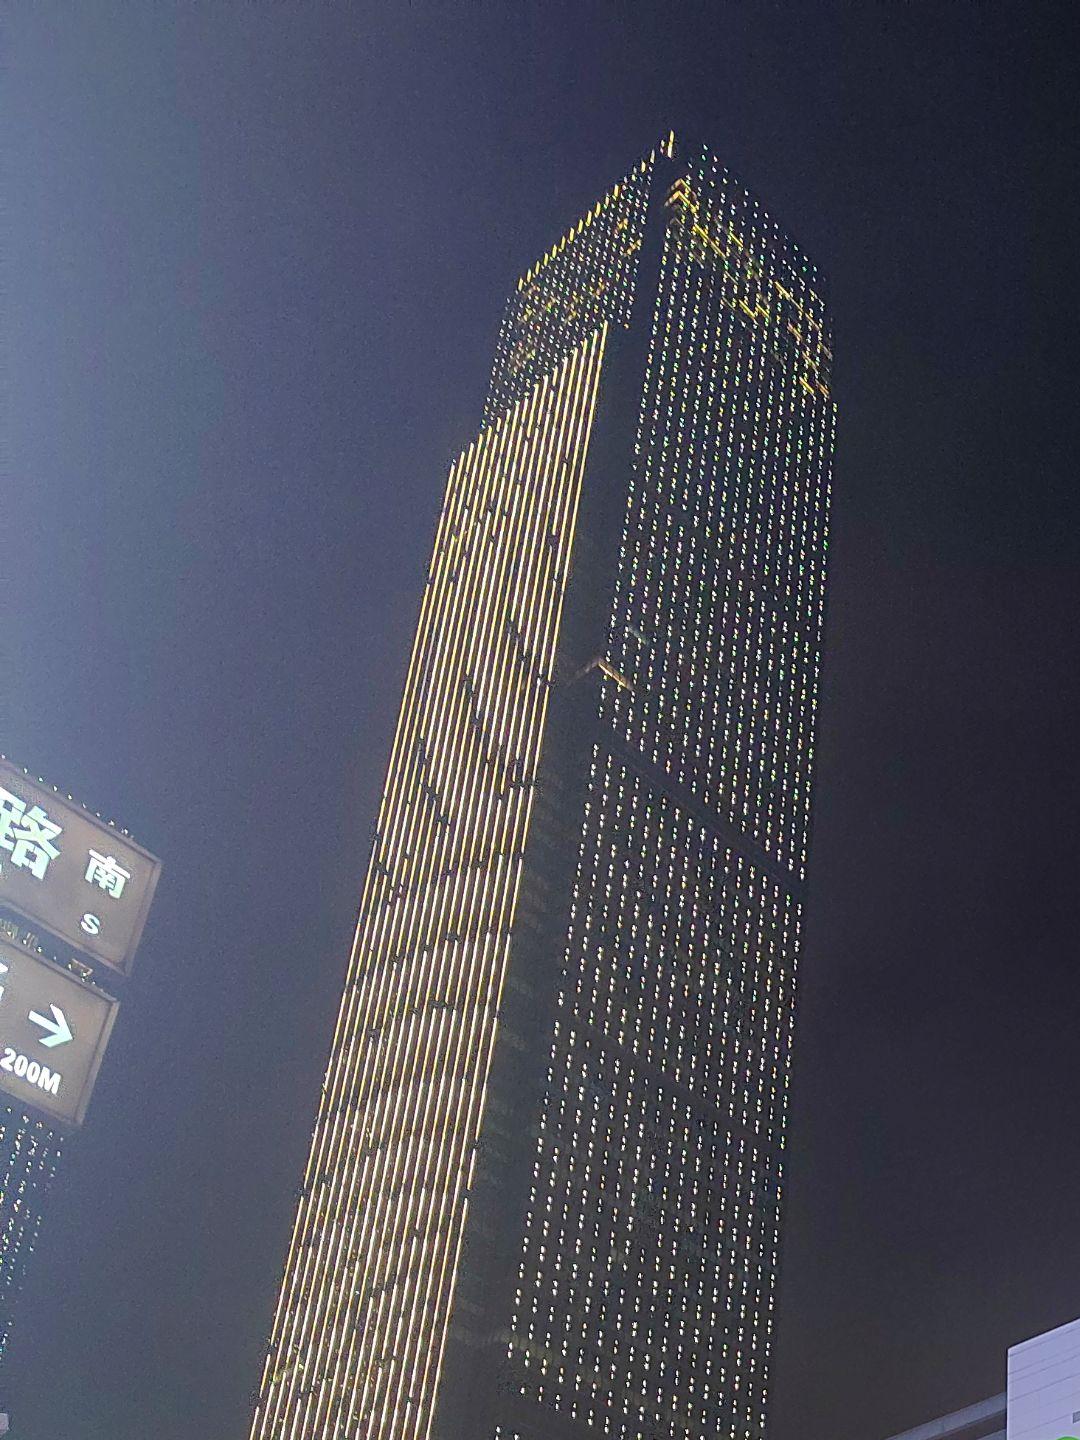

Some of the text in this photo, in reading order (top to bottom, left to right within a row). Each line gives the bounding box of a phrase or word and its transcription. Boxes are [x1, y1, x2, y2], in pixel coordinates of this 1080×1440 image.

[0, 786, 62, 880] 路
[85, 848, 131, 899] 南
[81, 913, 101, 935] S
[0, 1047, 62, 1095] 200M
